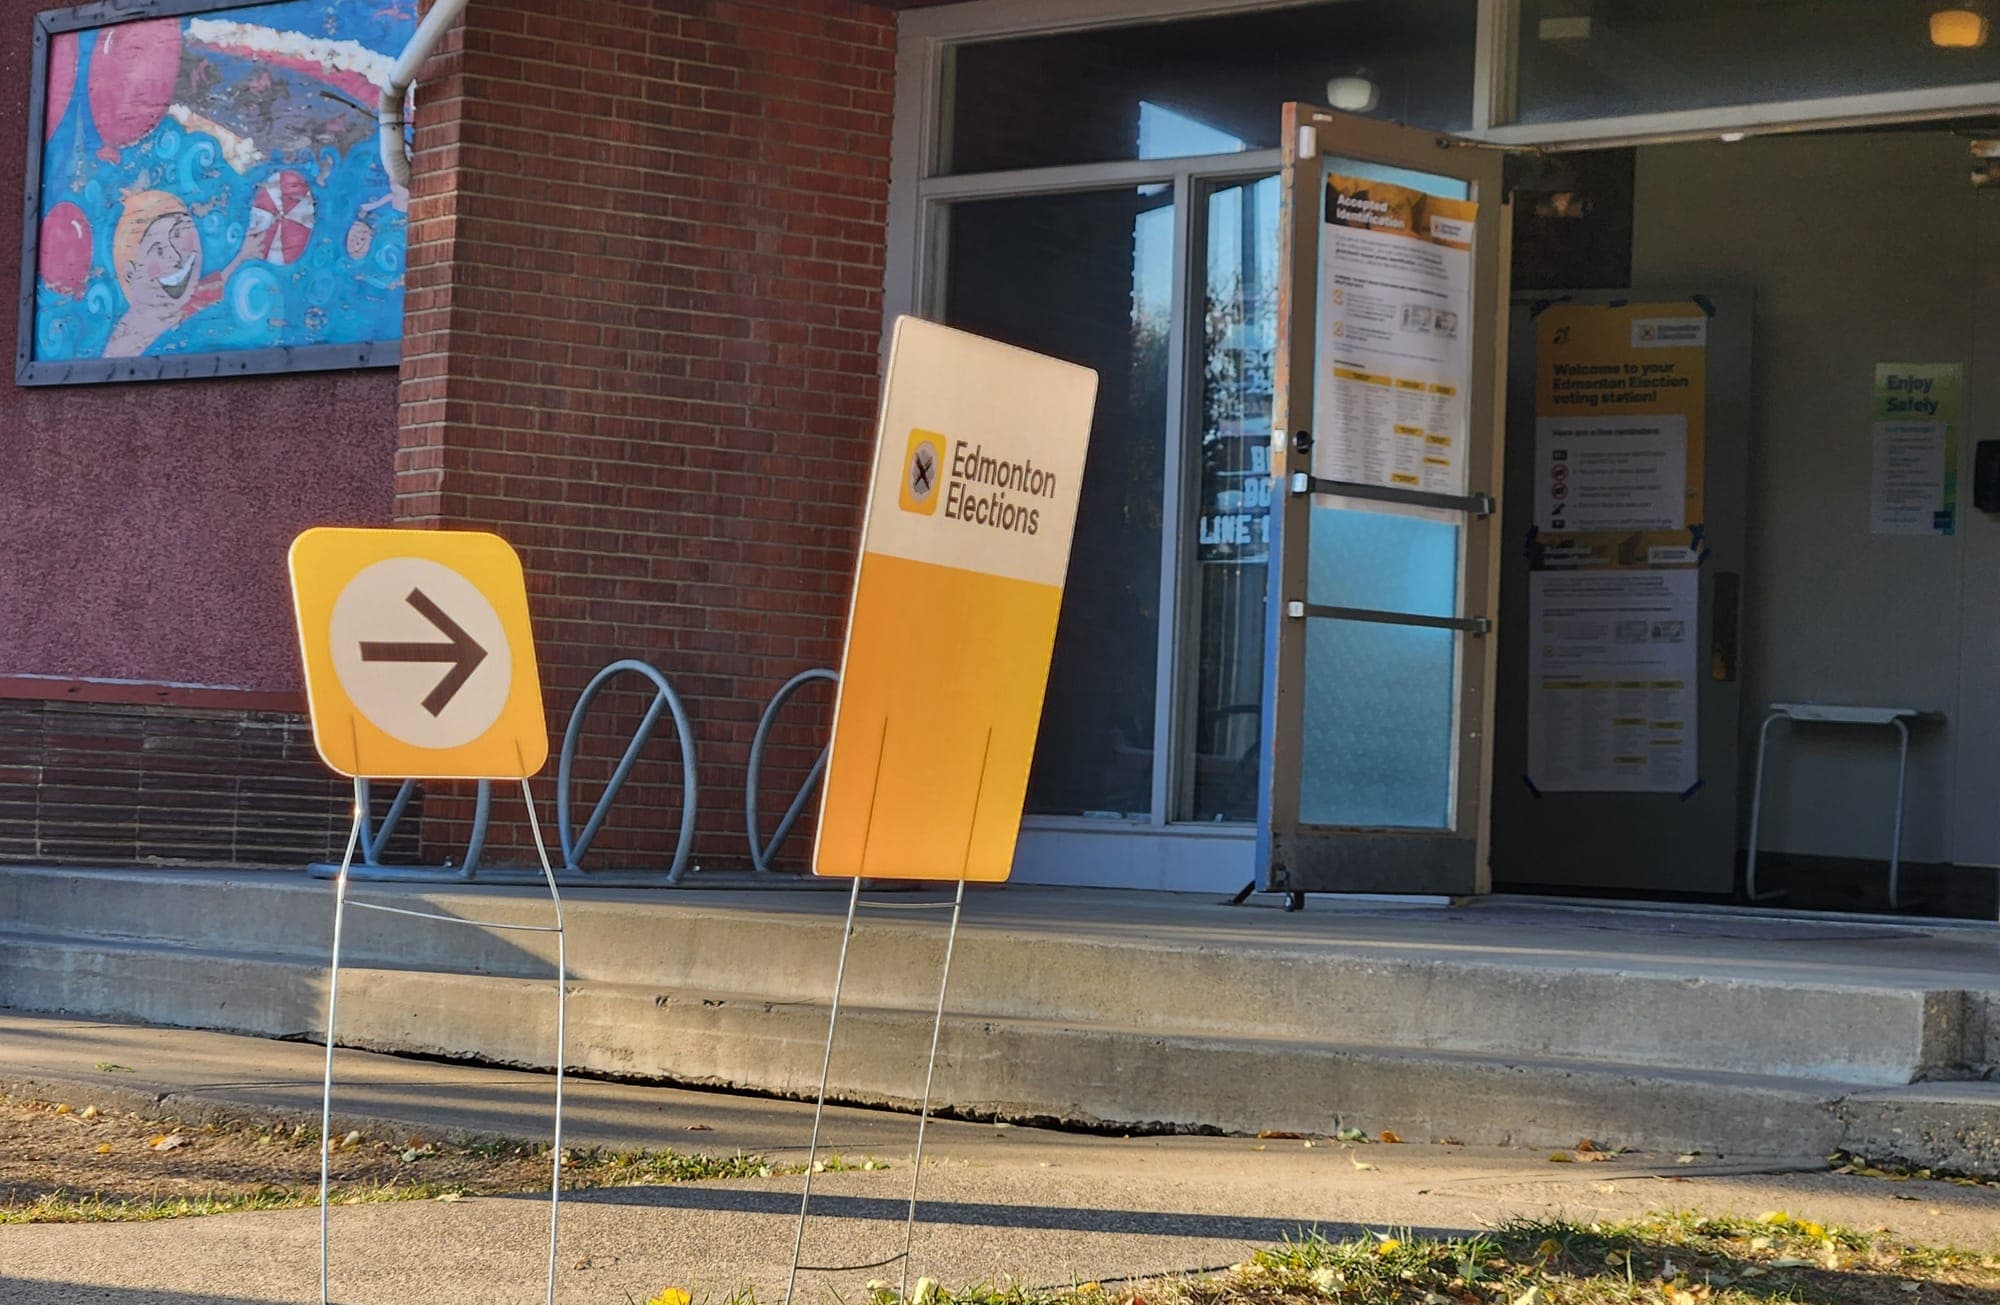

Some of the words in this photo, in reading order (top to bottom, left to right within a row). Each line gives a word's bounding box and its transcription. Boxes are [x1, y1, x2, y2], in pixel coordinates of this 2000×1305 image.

[1337, 194, 1389, 212] Accepted
[1336, 208, 1405, 229] Identification
[1552, 364, 1621, 375] Welcome
[1624, 364, 1638, 374] to
[1642, 363, 1675, 376] your
[1552, 377, 1626, 389] Edmonton
[1629, 376, 1689, 388] Election
[1886, 374, 1934, 392] Enjoy
[1552, 391, 1598, 406] voting
[1602, 390, 1657, 404] station!
[1886, 396, 1938, 415] Safely
[951, 440, 1056, 499] Edmonton
[945, 481, 1040, 535] Elections
